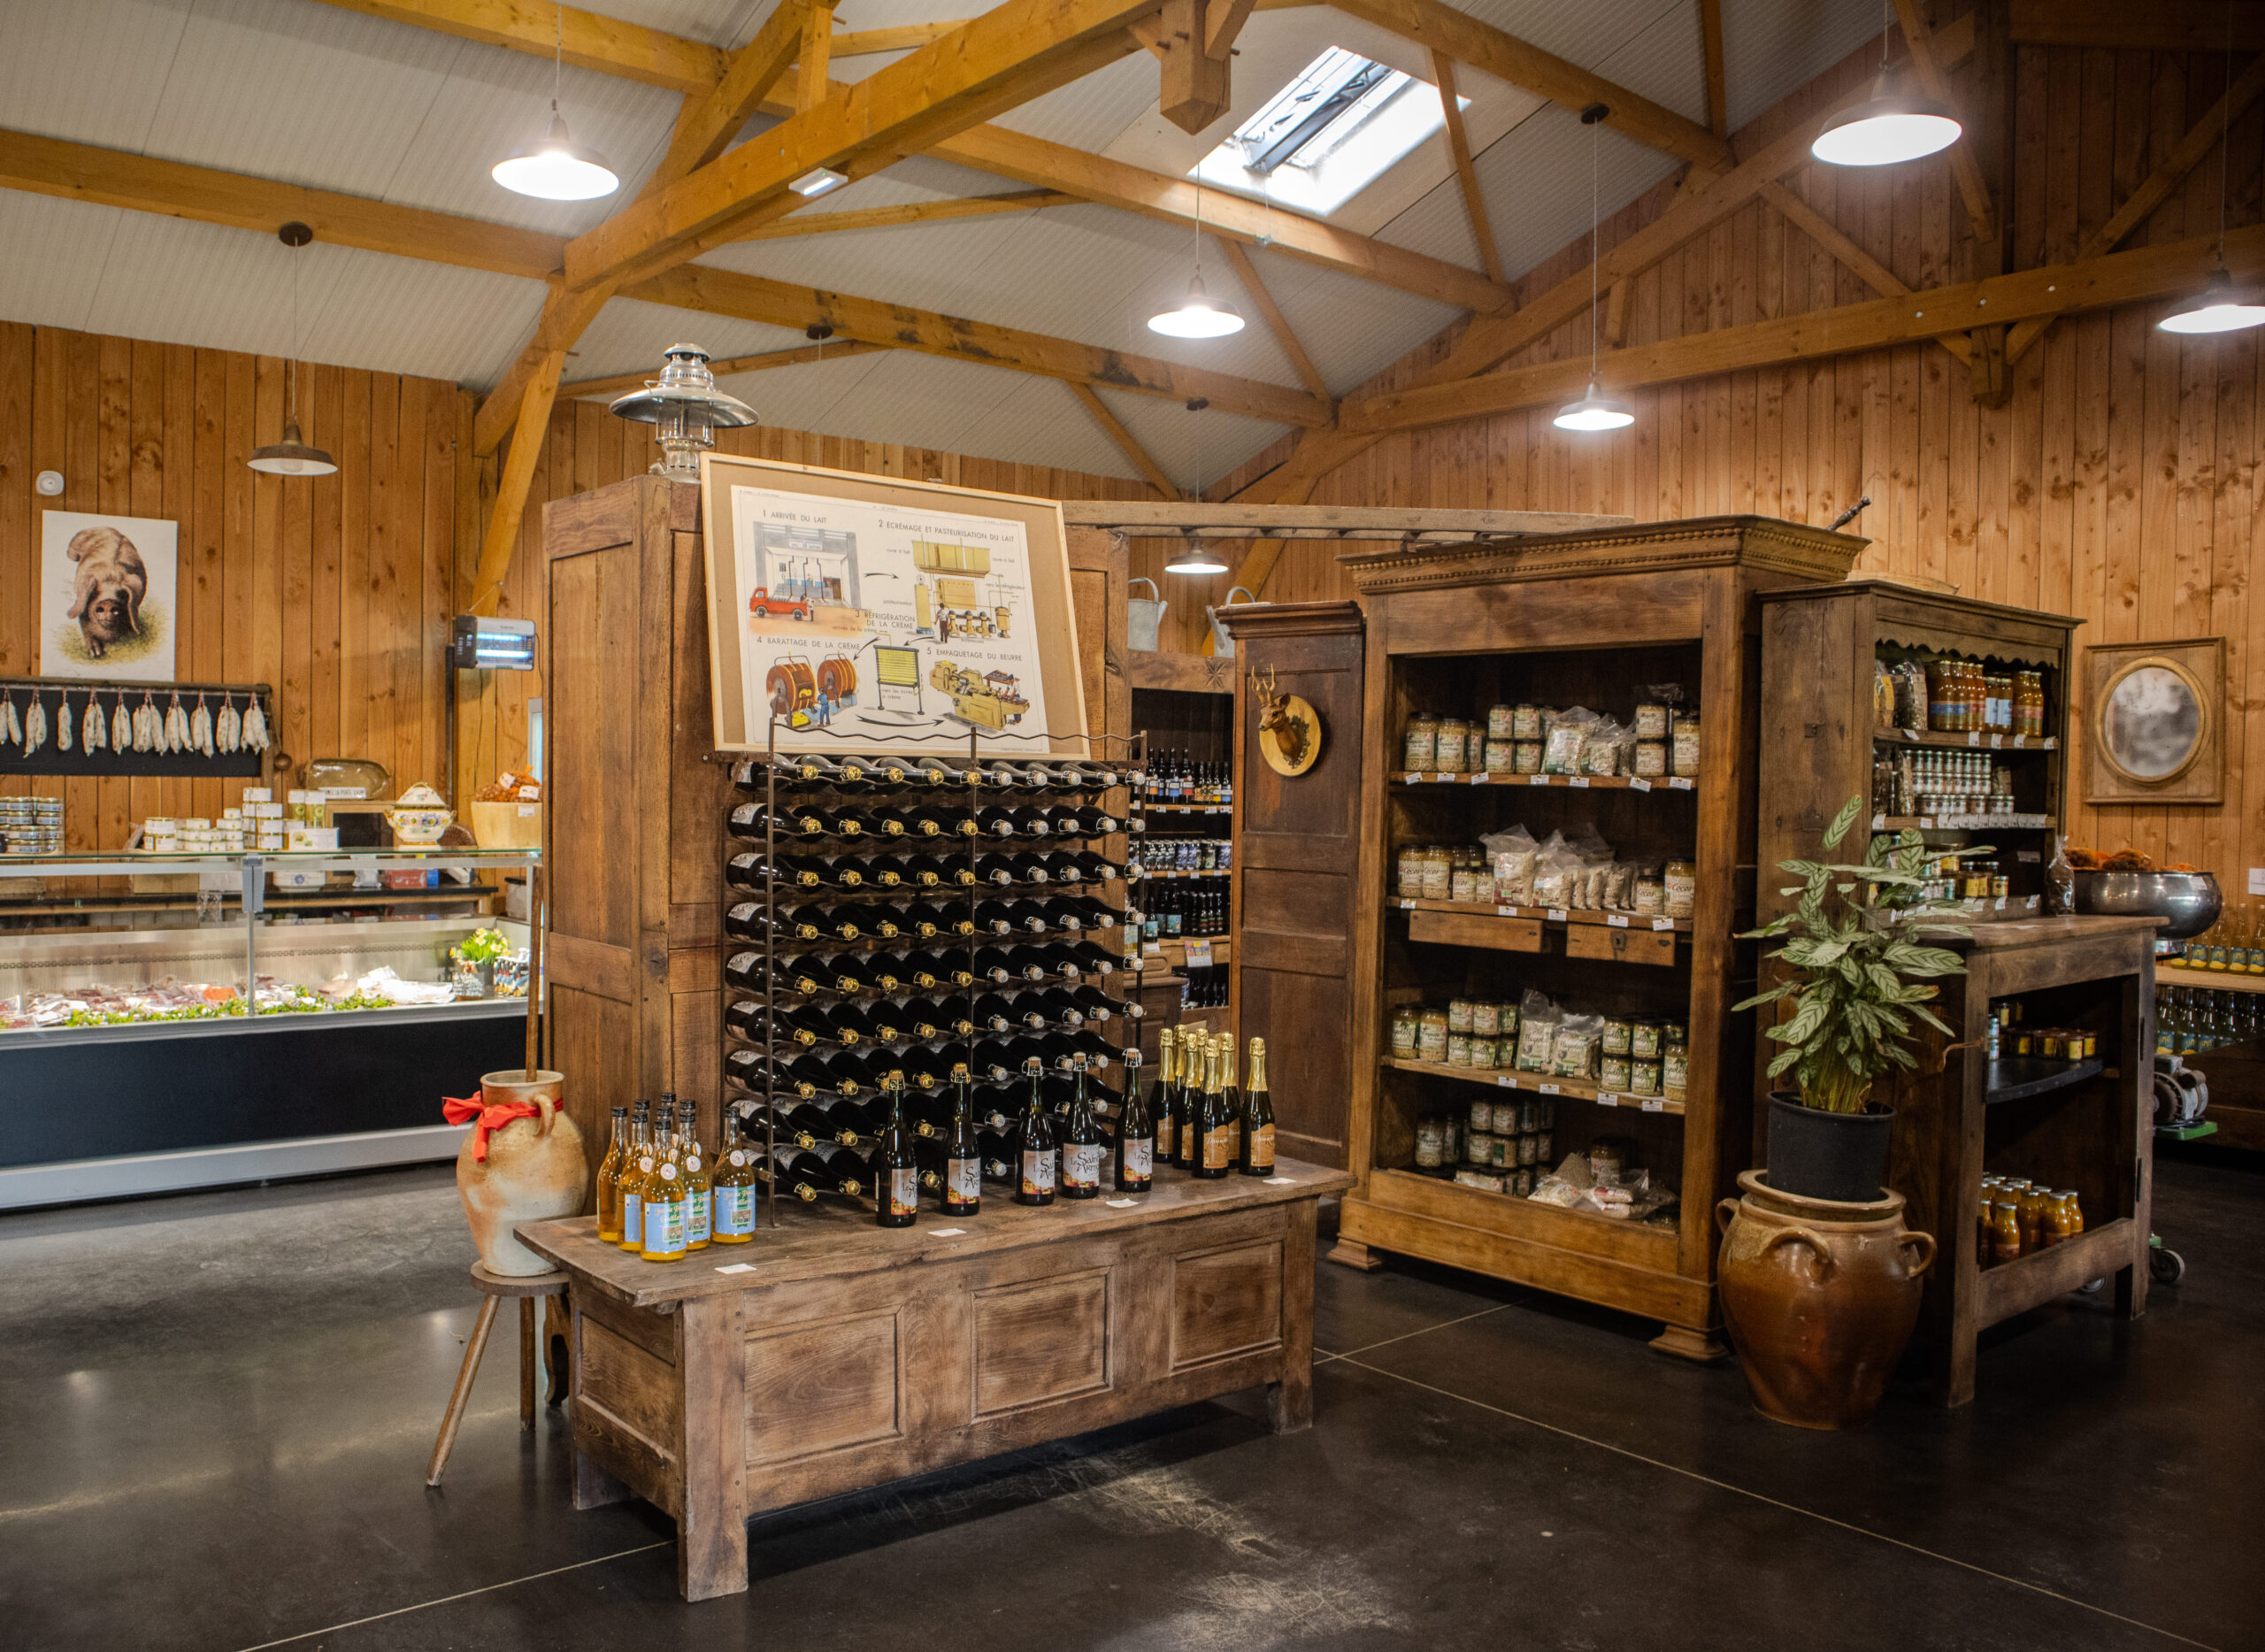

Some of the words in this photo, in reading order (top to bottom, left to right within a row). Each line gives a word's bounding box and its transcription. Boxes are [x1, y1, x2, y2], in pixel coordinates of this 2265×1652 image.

[771, 511, 796, 520] ARRIVÉE
[878, 519, 884, 528] 2
[934, 527, 987, 540] PASTEURISATION
[864, 611, 916, 622] RÉFRIGÉRATION
[767, 637, 808, 646] BARATTAGE
[926, 647, 932, 656] 5
[936, 649, 983, 658] EMPAQUETAGE
